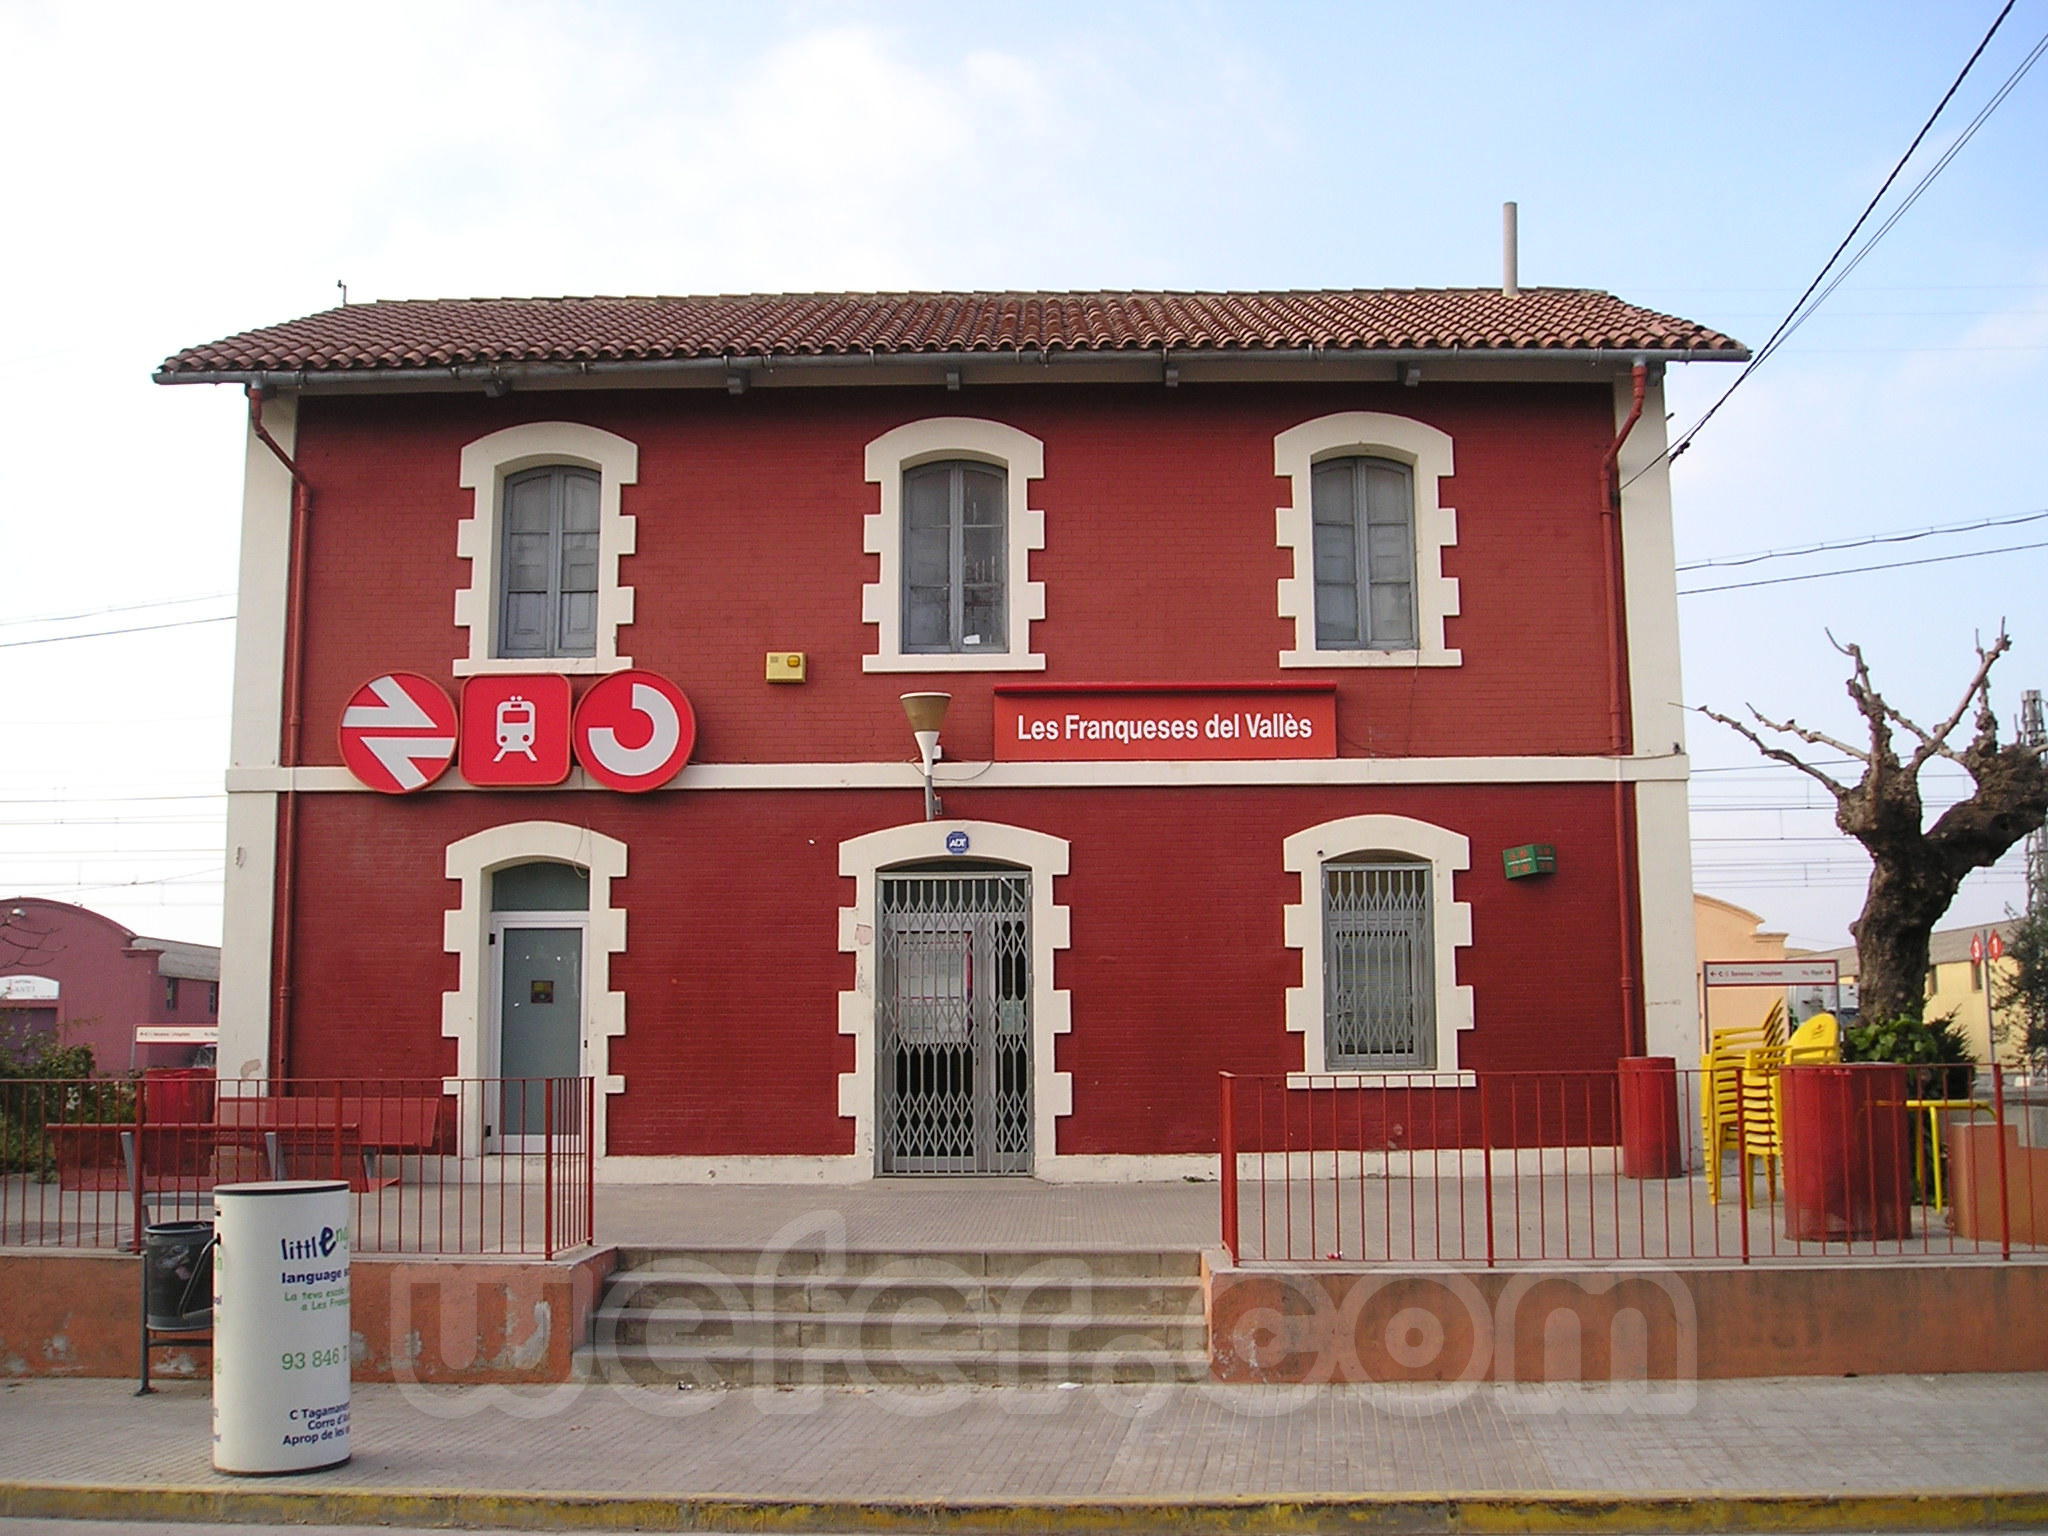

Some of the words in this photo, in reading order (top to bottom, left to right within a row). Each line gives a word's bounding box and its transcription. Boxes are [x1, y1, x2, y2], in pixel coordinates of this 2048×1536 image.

[1017, 714, 1059, 740] Les
[1065, 714, 1199, 744] Franqueses
[1204, 713, 1240, 739] del
[1245, 712, 1313, 738] Vallès
[282, 1269, 342, 1285] language
[284, 1291, 297, 1302] La
[281, 1352, 306, 1370] 93
[312, 1347, 340, 1368] 846
[289, 1409, 298, 1420] C
[282, 1434, 319, 1446] Aprop
[321, 1429, 333, 1440] de
